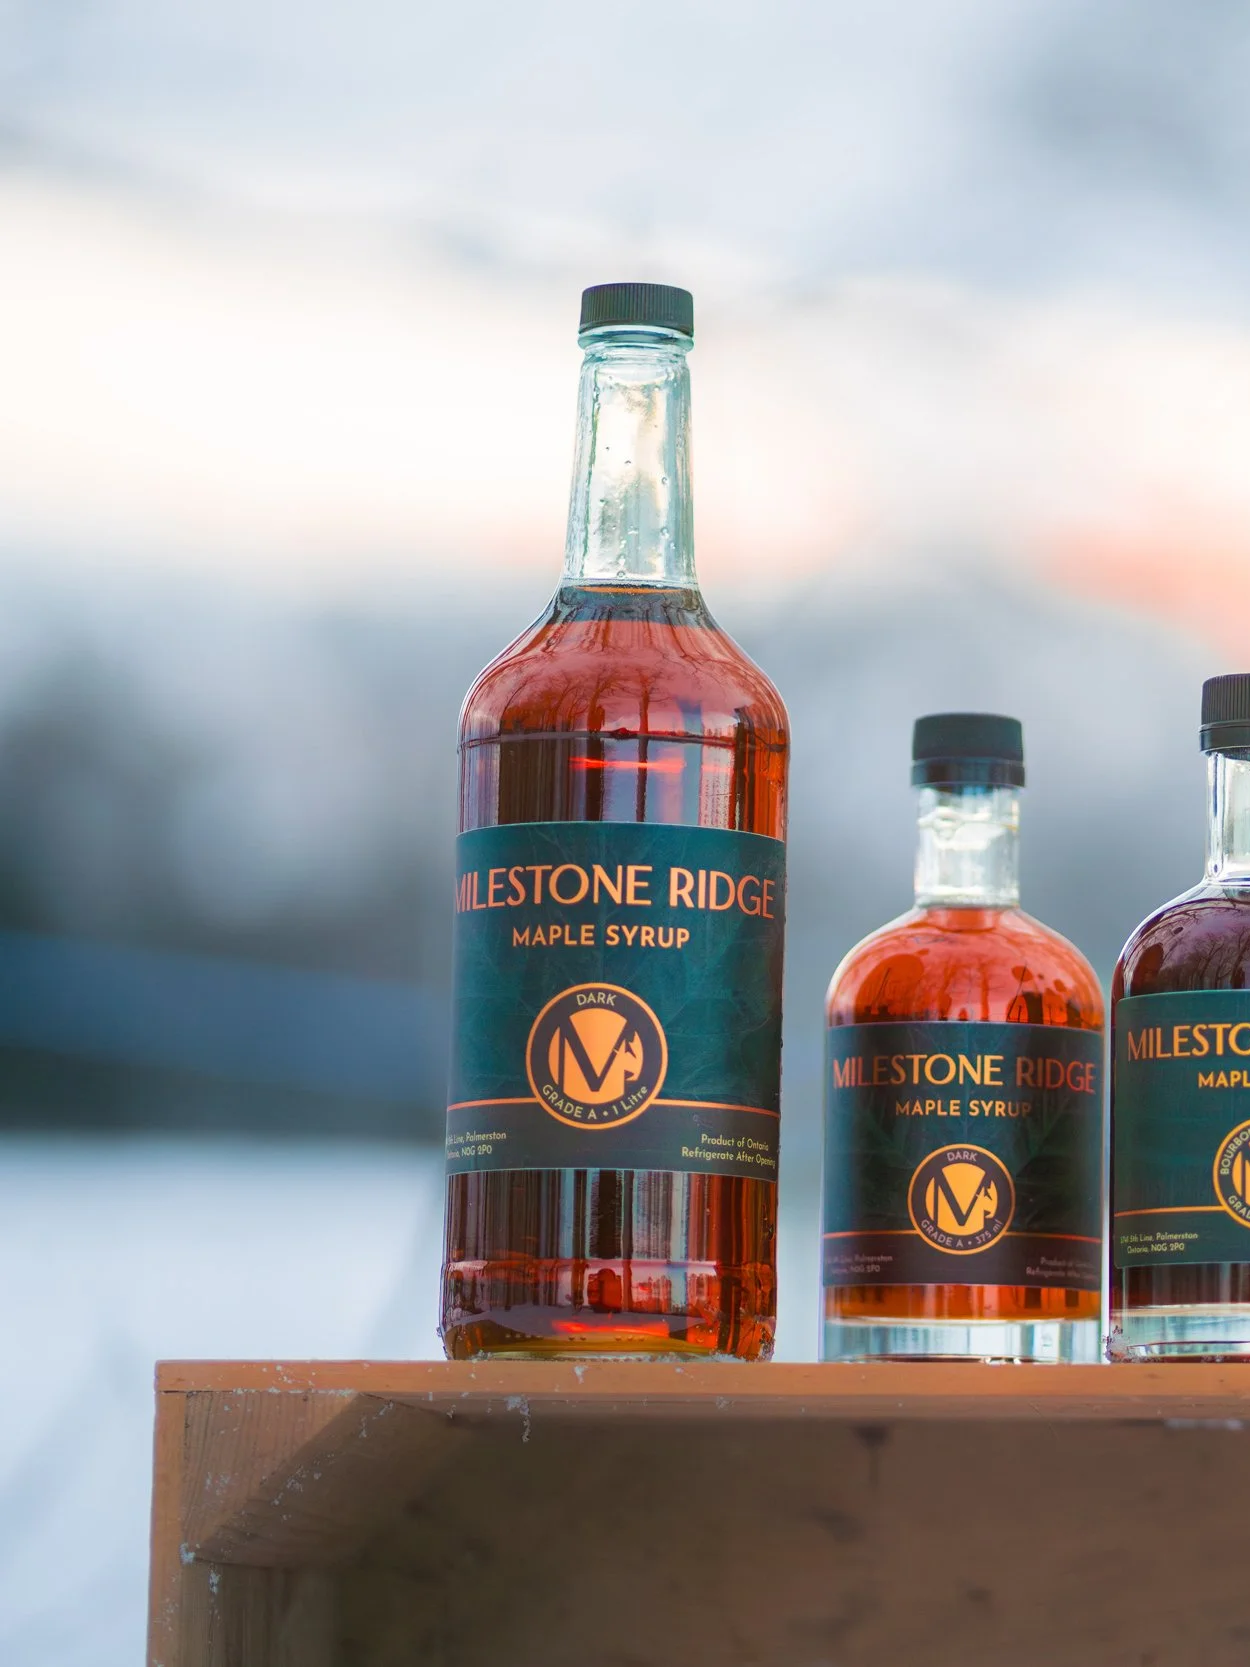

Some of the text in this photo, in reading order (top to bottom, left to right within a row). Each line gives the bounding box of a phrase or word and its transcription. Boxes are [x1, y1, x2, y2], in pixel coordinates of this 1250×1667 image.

[456, 864, 776, 919] MILESTONE RIDGE
[512, 924, 690, 949] MAPLE SYRUP
[576, 992, 618, 1006] DARK
[832, 1053, 1097, 1095] MILESTONE RIDGE
[542, 1084, 583, 1118] GRADE
[587, 1109, 597, 1120] A
[621, 1085, 648, 1111] Litre
[895, 1099, 1032, 1117] MAPLE SYRUP
[466, 1130, 506, 1141] Palmerston
[701, 1133, 734, 1146] Product
[737, 1137, 745, 1148] of
[681, 1146, 734, 1161] Refrigerate
[736, 1151, 754, 1163] After
[946, 1150, 979, 1162] DARK
[921, 1219, 952, 1247] GRADE
[956, 1239, 964, 1248] A
[974, 1230, 992, 1244] 375
[1156, 1231, 1199, 1241] Palmerston
